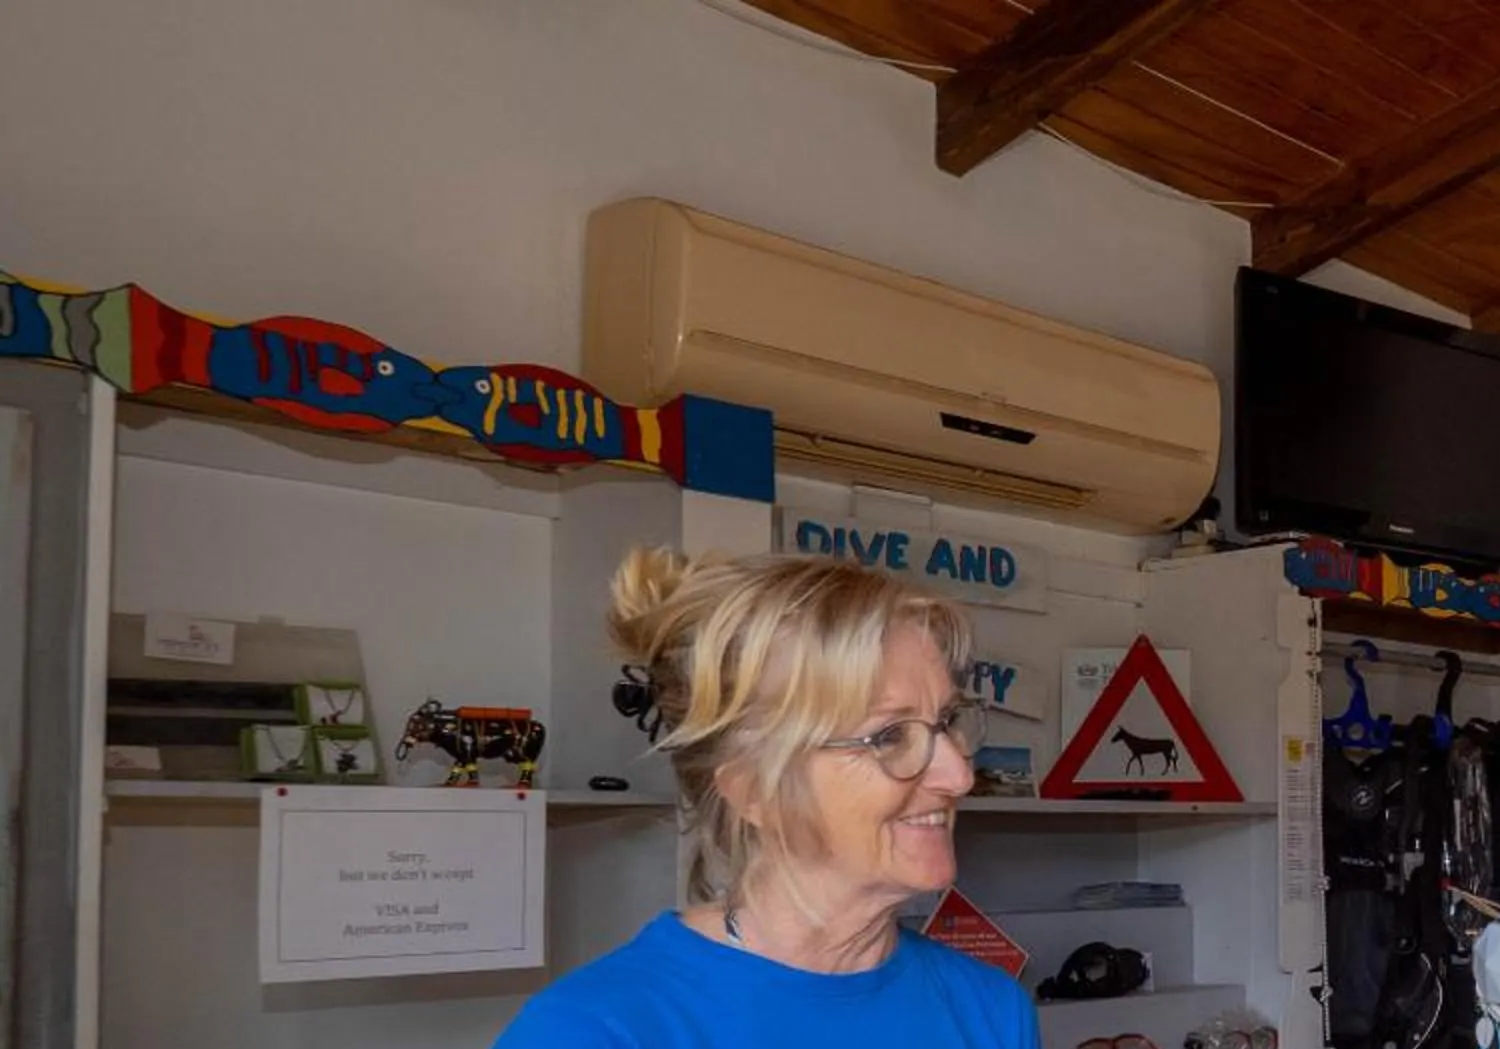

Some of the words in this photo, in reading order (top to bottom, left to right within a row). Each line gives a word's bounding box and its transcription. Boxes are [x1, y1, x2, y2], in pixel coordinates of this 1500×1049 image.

[796, 520, 910, 570] DIVE
[926, 537, 1016, 587] AND
[339, 869, 364, 882] but
[367, 870, 389, 881] we
[391, 869, 427, 881] don't
[375, 903, 409, 916] VISA
[413, 900, 439, 915] and
[342, 923, 412, 938] American
[415, 920, 469, 935] Express
